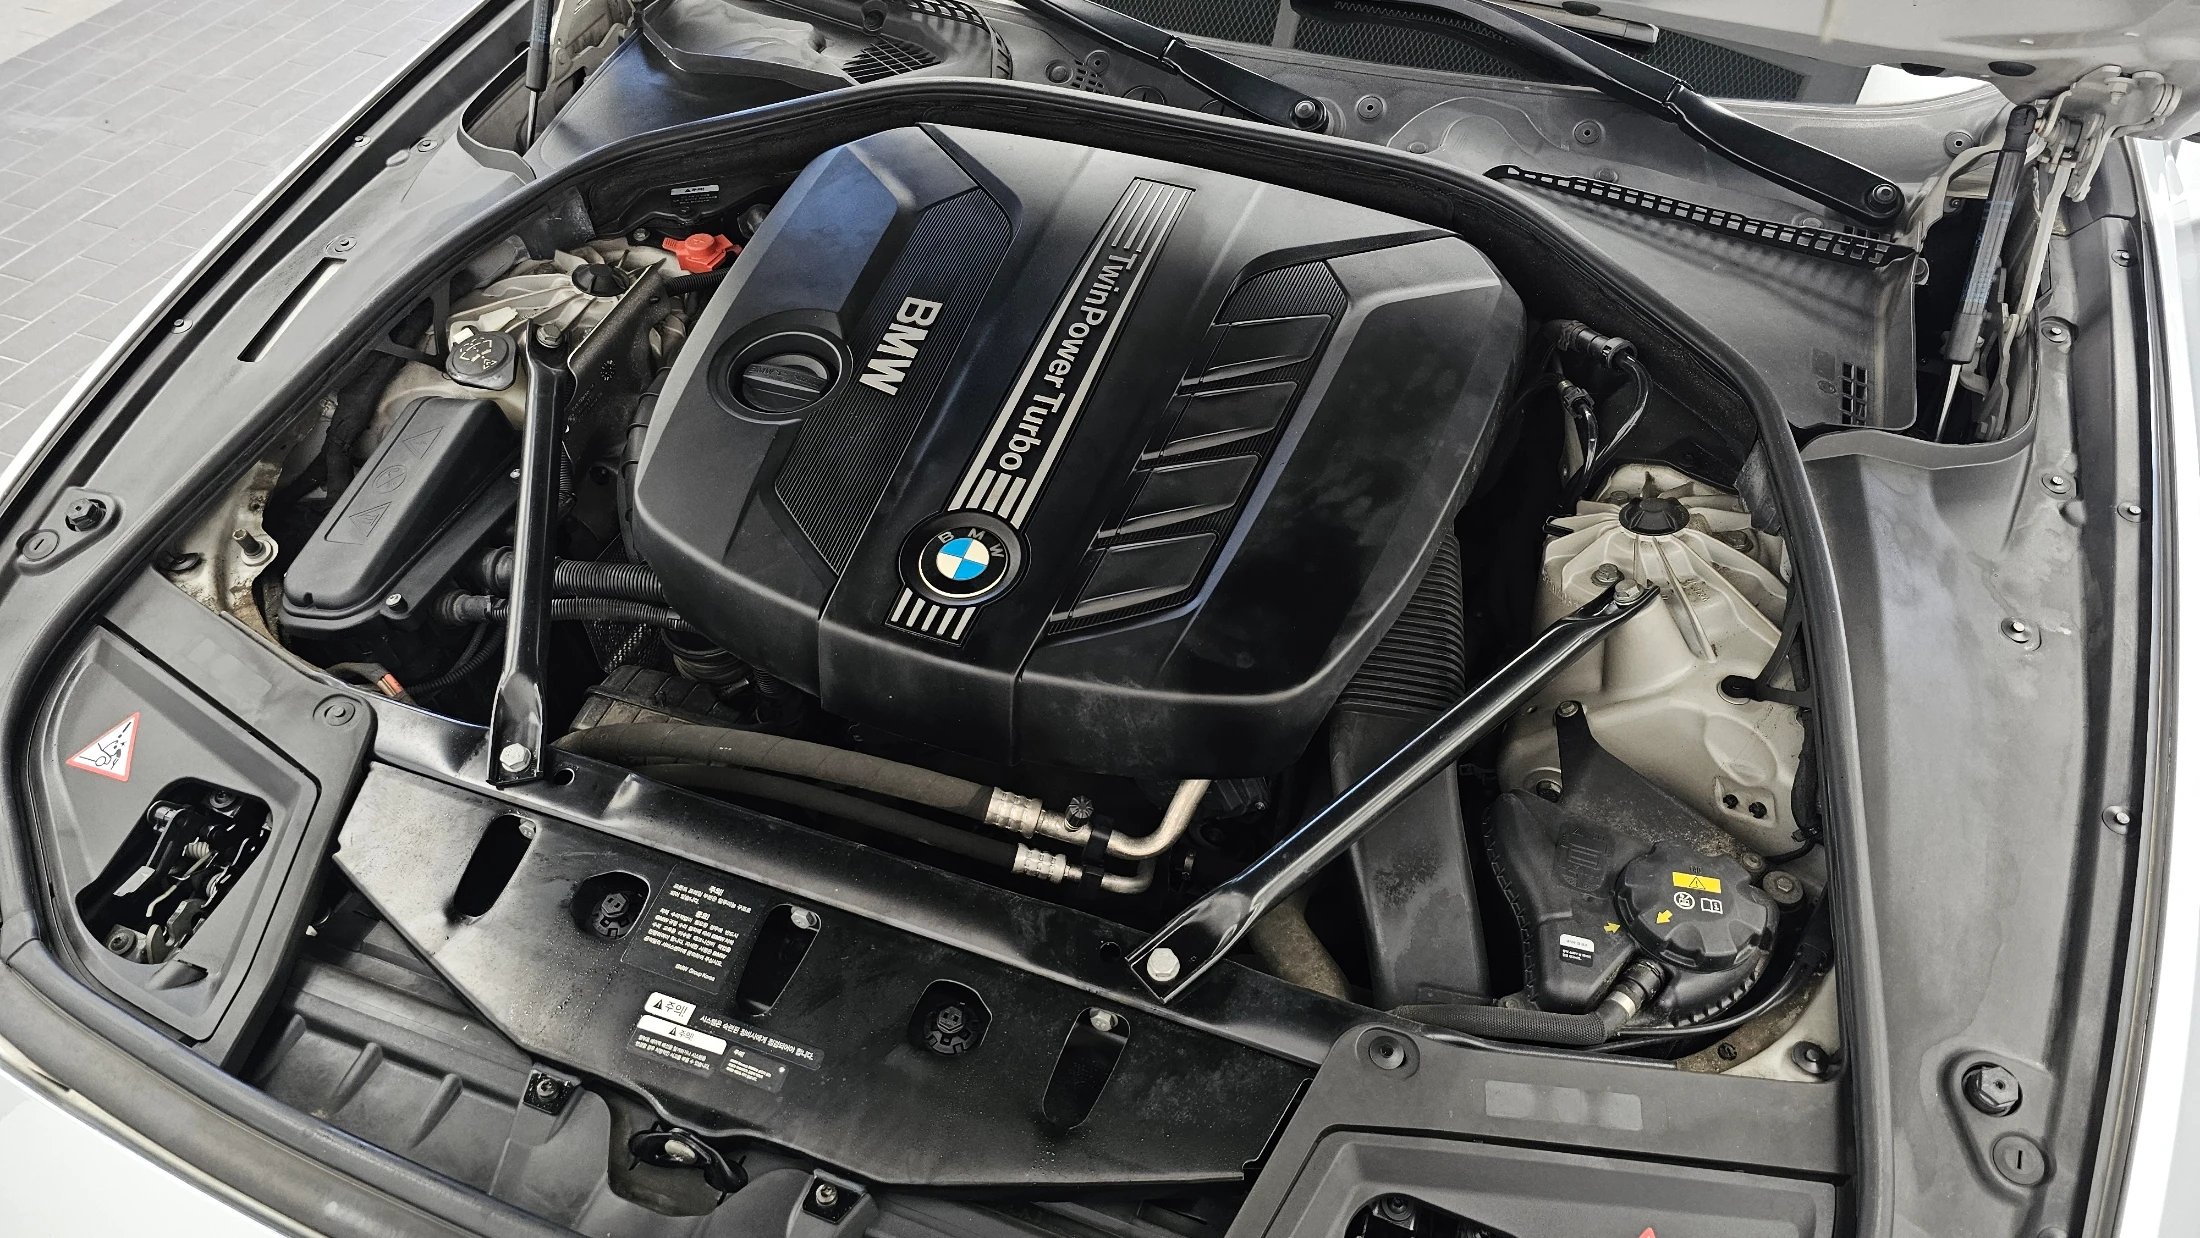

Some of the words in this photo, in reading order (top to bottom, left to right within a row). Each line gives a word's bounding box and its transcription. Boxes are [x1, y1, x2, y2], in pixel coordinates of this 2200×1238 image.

[859, 296, 944, 396] BMW
[1043, 254, 1138, 389] TwinPower
[999, 392, 1066, 471] Turbo
[938, 528, 1005, 558] BMW
[665, 1000, 688, 1018] 주의!
[678, 1030, 694, 1041] 주의!
